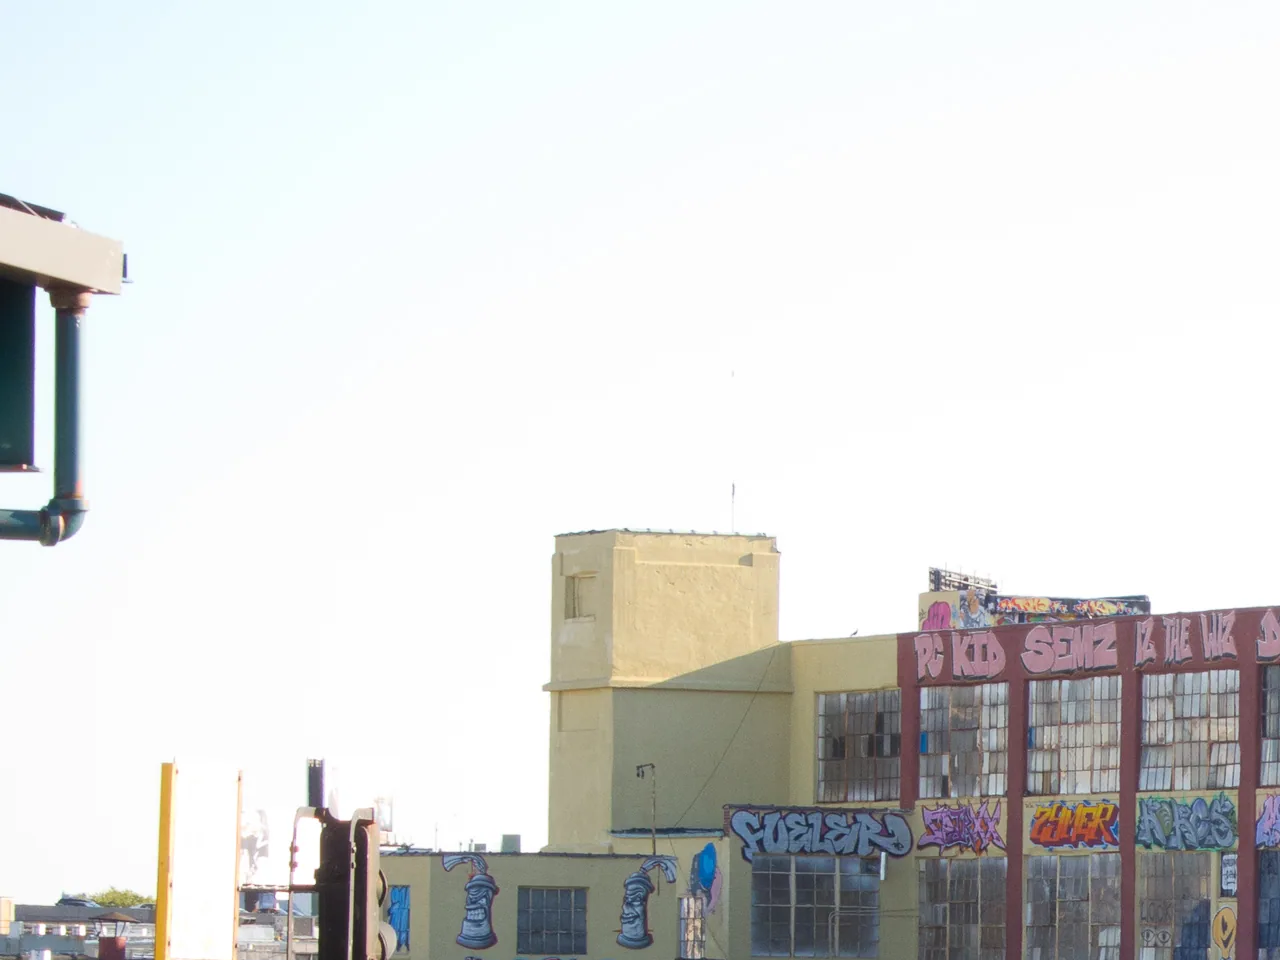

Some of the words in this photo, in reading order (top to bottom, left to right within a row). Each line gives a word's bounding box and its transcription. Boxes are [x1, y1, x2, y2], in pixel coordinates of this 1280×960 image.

[914, 633, 945, 682] PC
[951, 629, 1006, 681] KID
[1020, 621, 1118, 674] SEMZ
[1161, 615, 1193, 665] THE
[1201, 610, 1238, 661] WIZ
